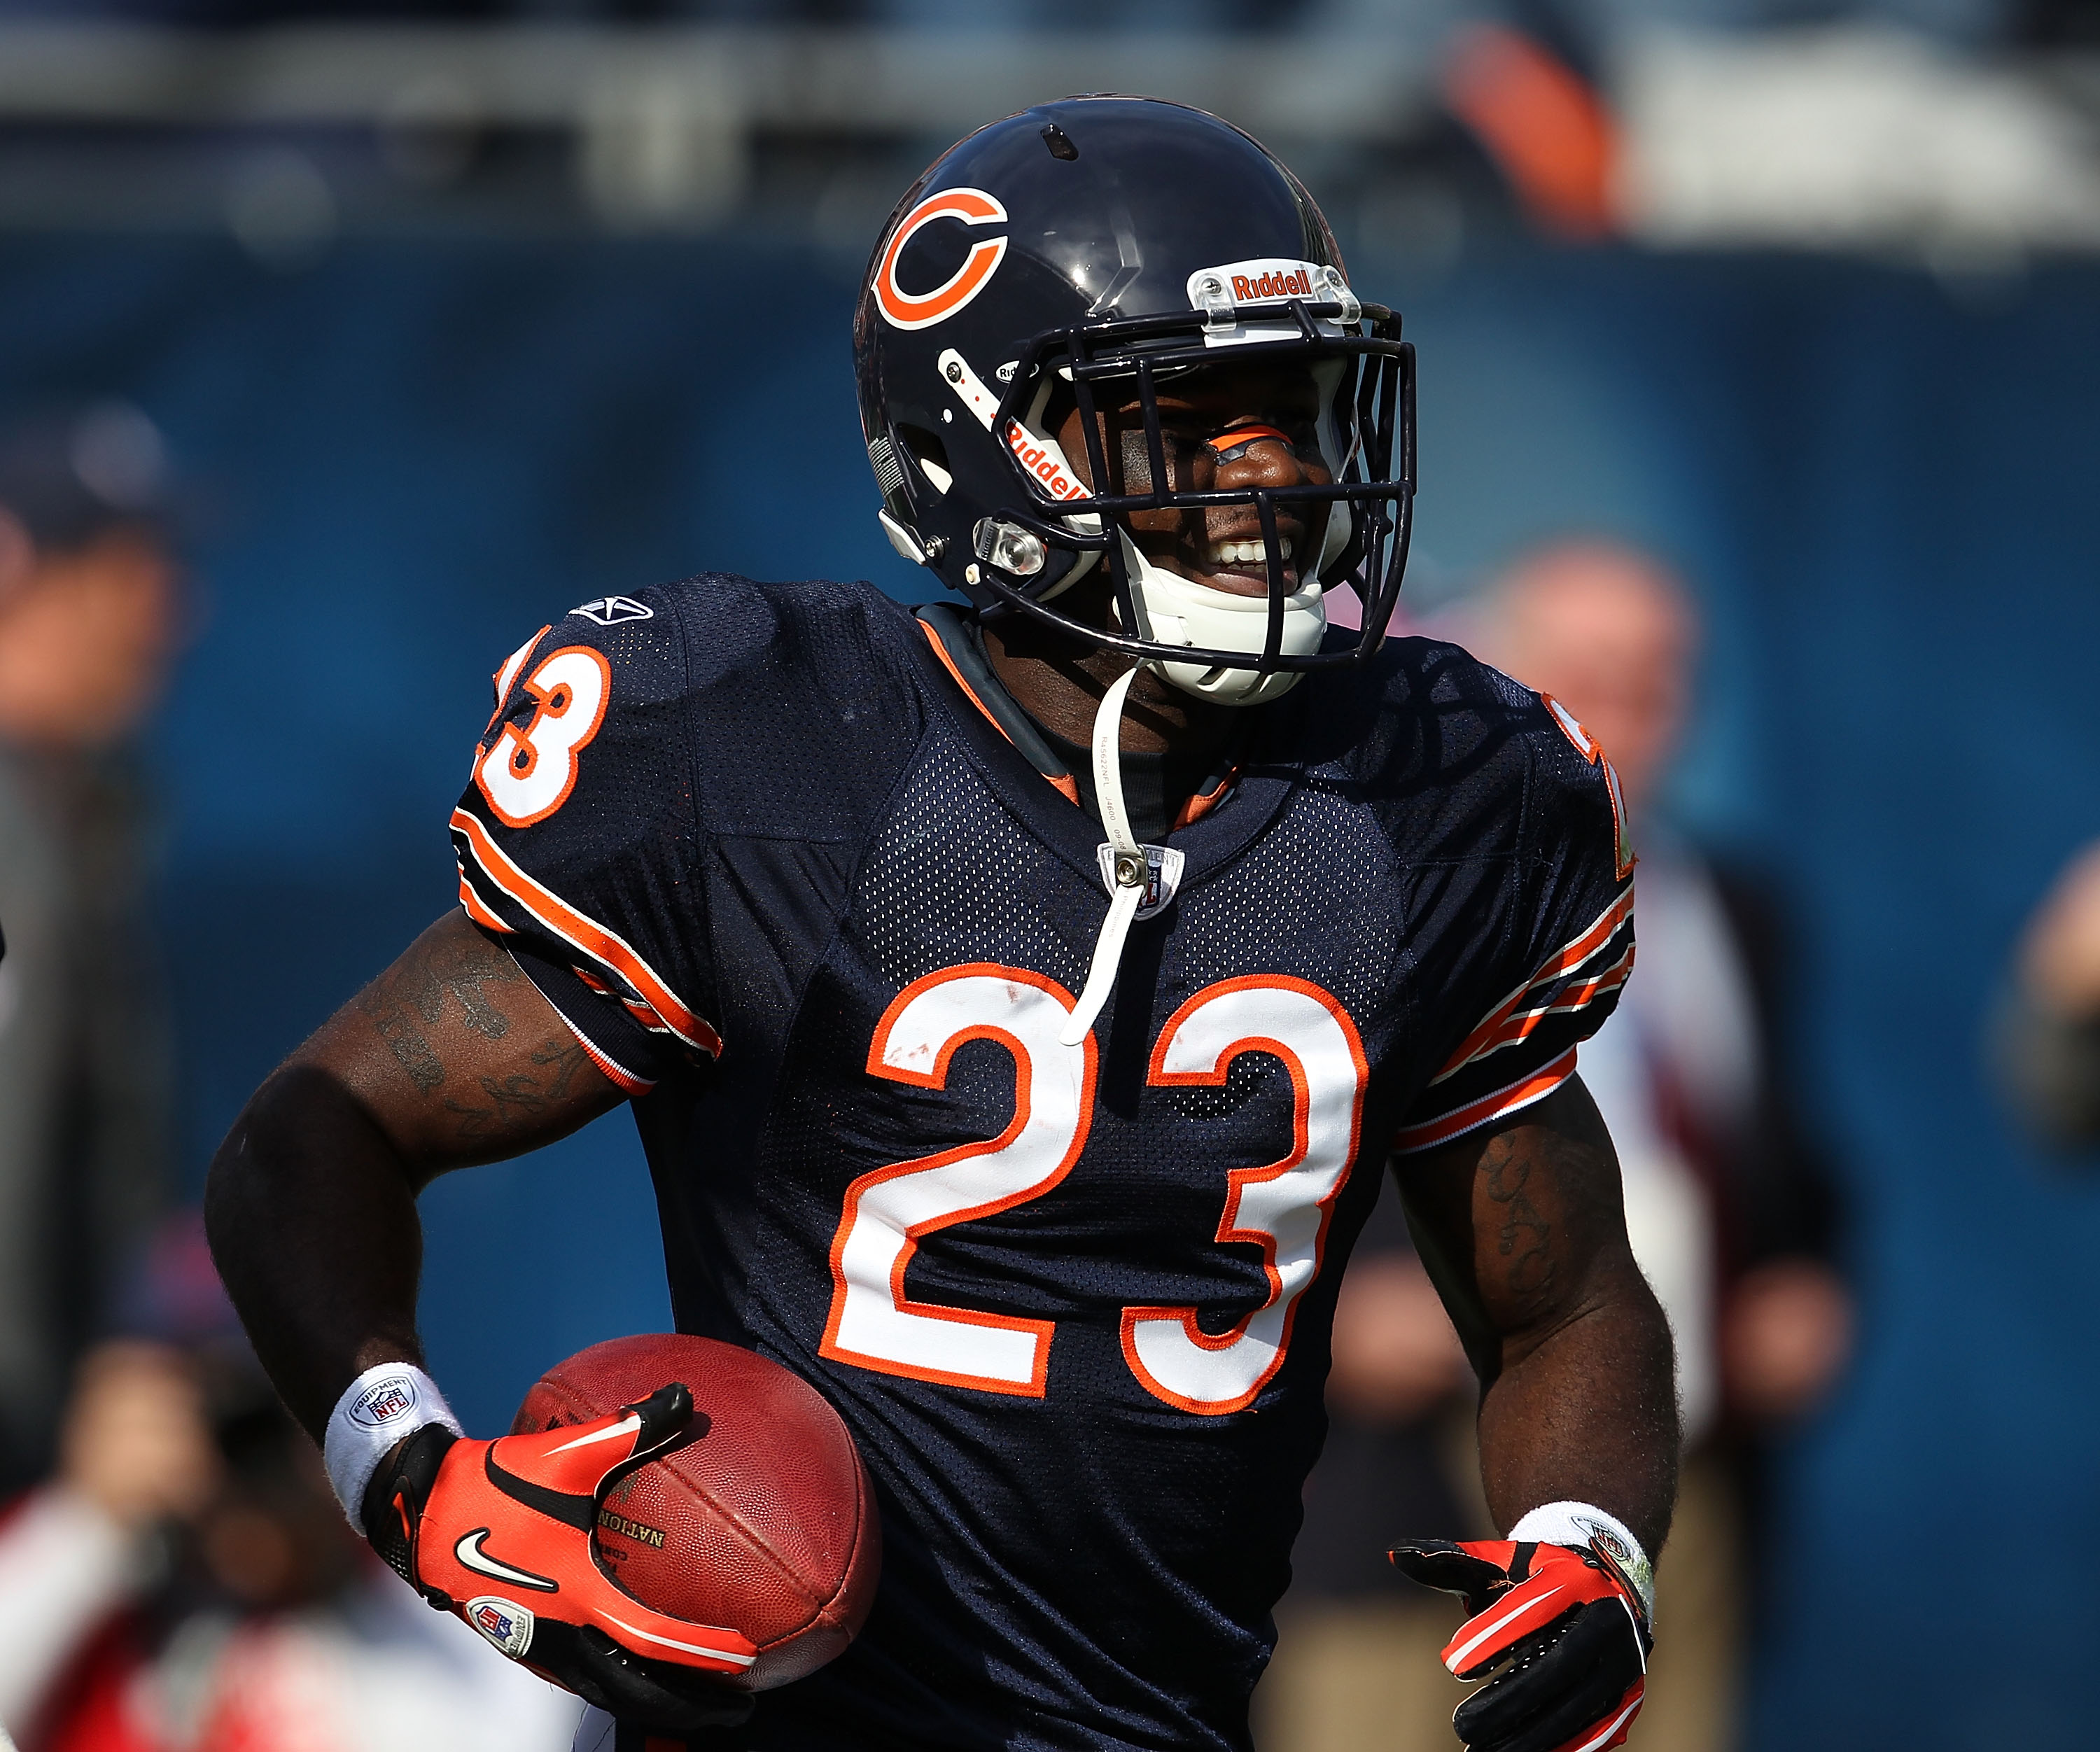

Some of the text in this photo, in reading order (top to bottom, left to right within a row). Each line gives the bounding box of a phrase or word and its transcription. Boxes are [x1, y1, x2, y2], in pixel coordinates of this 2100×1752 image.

[1231, 269, 1312, 301] Riddell
[818, 962, 1370, 1415] 23
[354, 1379, 407, 1415] EQUIPMENT
[375, 1397, 407, 1419] NFL
